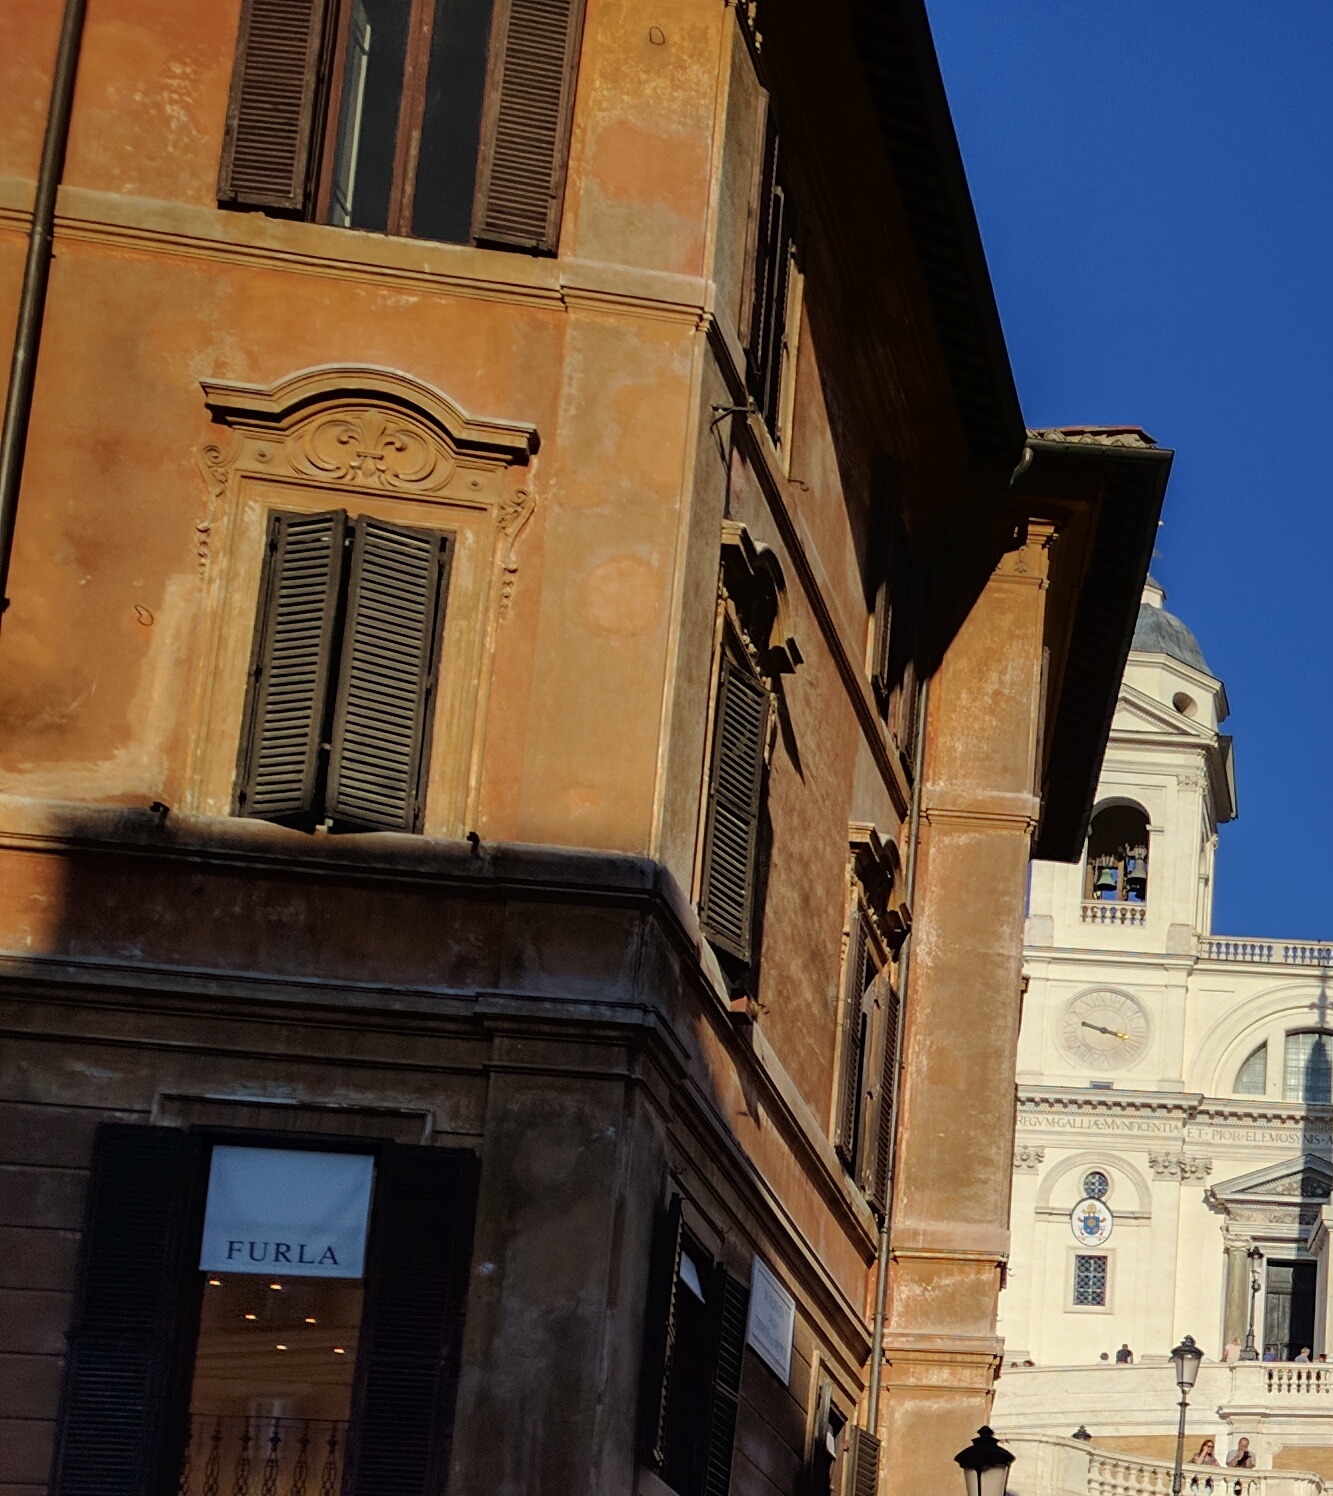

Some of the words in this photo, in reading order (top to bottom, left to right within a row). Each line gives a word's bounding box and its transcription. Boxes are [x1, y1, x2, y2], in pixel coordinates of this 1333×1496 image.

[1187, 1129, 1205, 1139] ET
[1211, 1130, 1243, 1141] PIOR
[225, 1240, 340, 1265] FURLA
